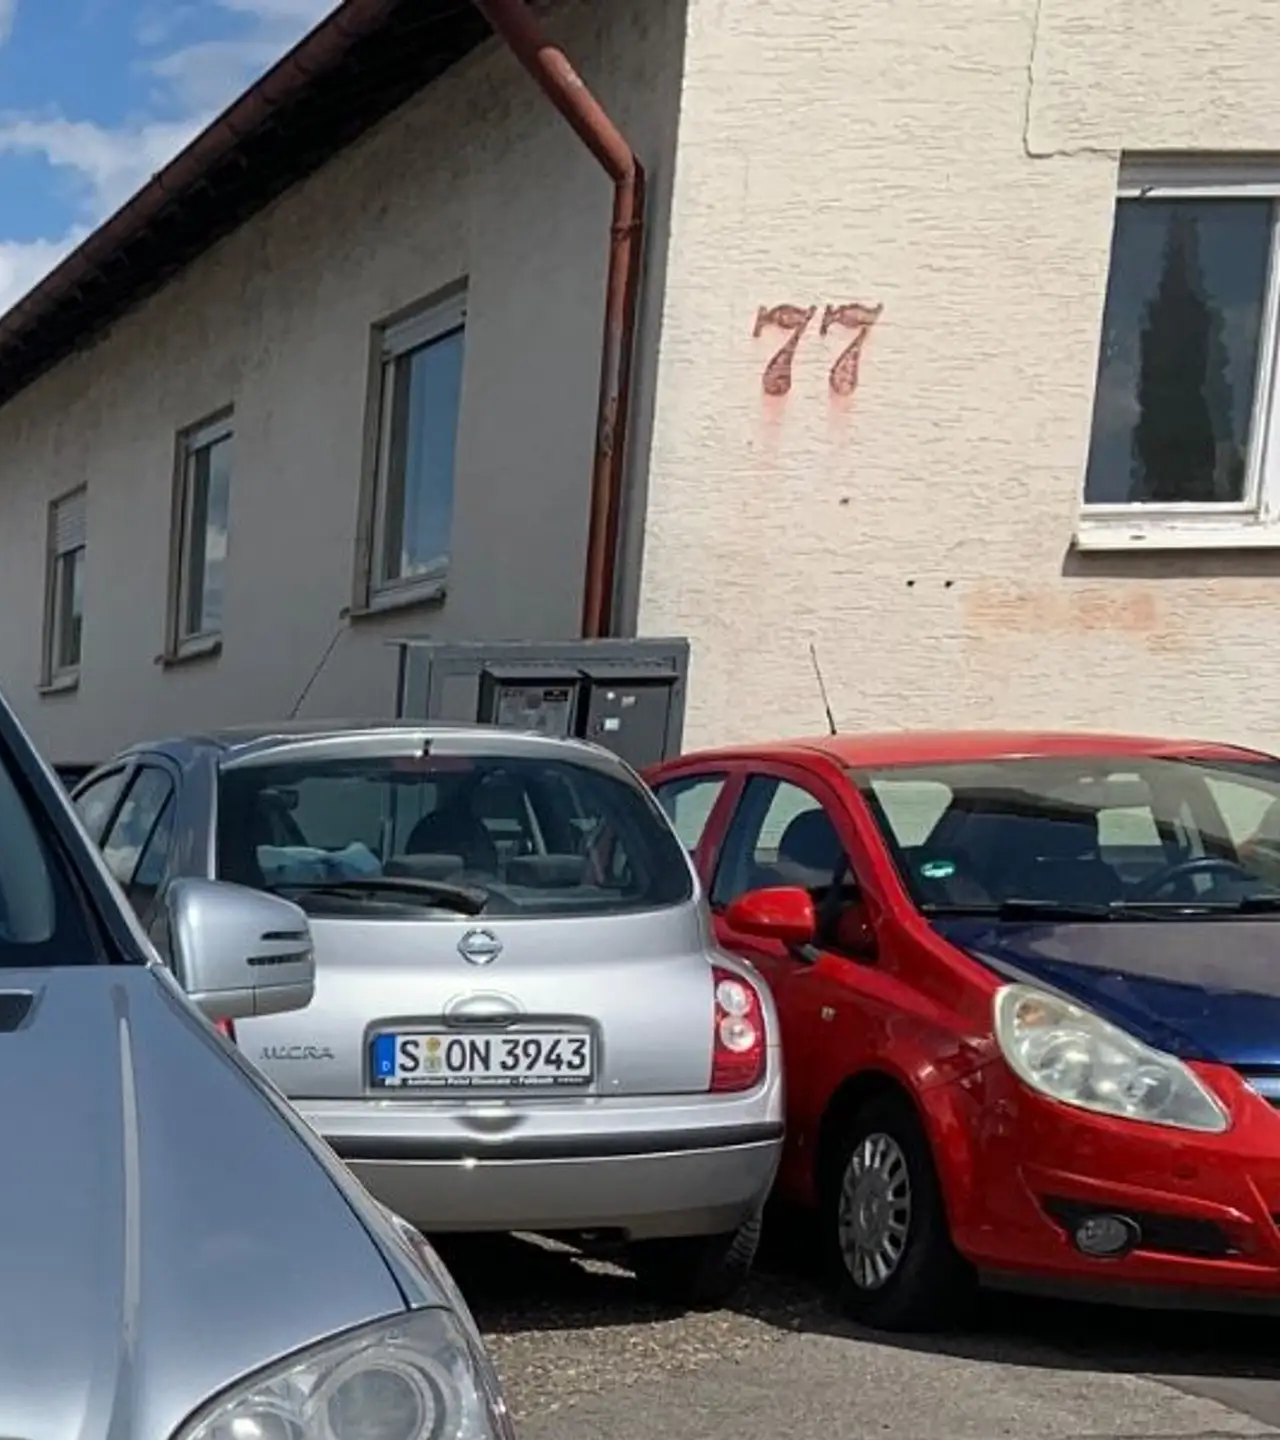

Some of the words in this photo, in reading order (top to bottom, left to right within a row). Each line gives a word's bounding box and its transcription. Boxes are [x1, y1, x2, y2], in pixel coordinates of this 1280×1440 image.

[752, 303, 883, 396] 77
[445, 1038, 491, 1073] ON
[499, 1038, 588, 1072] 3943
